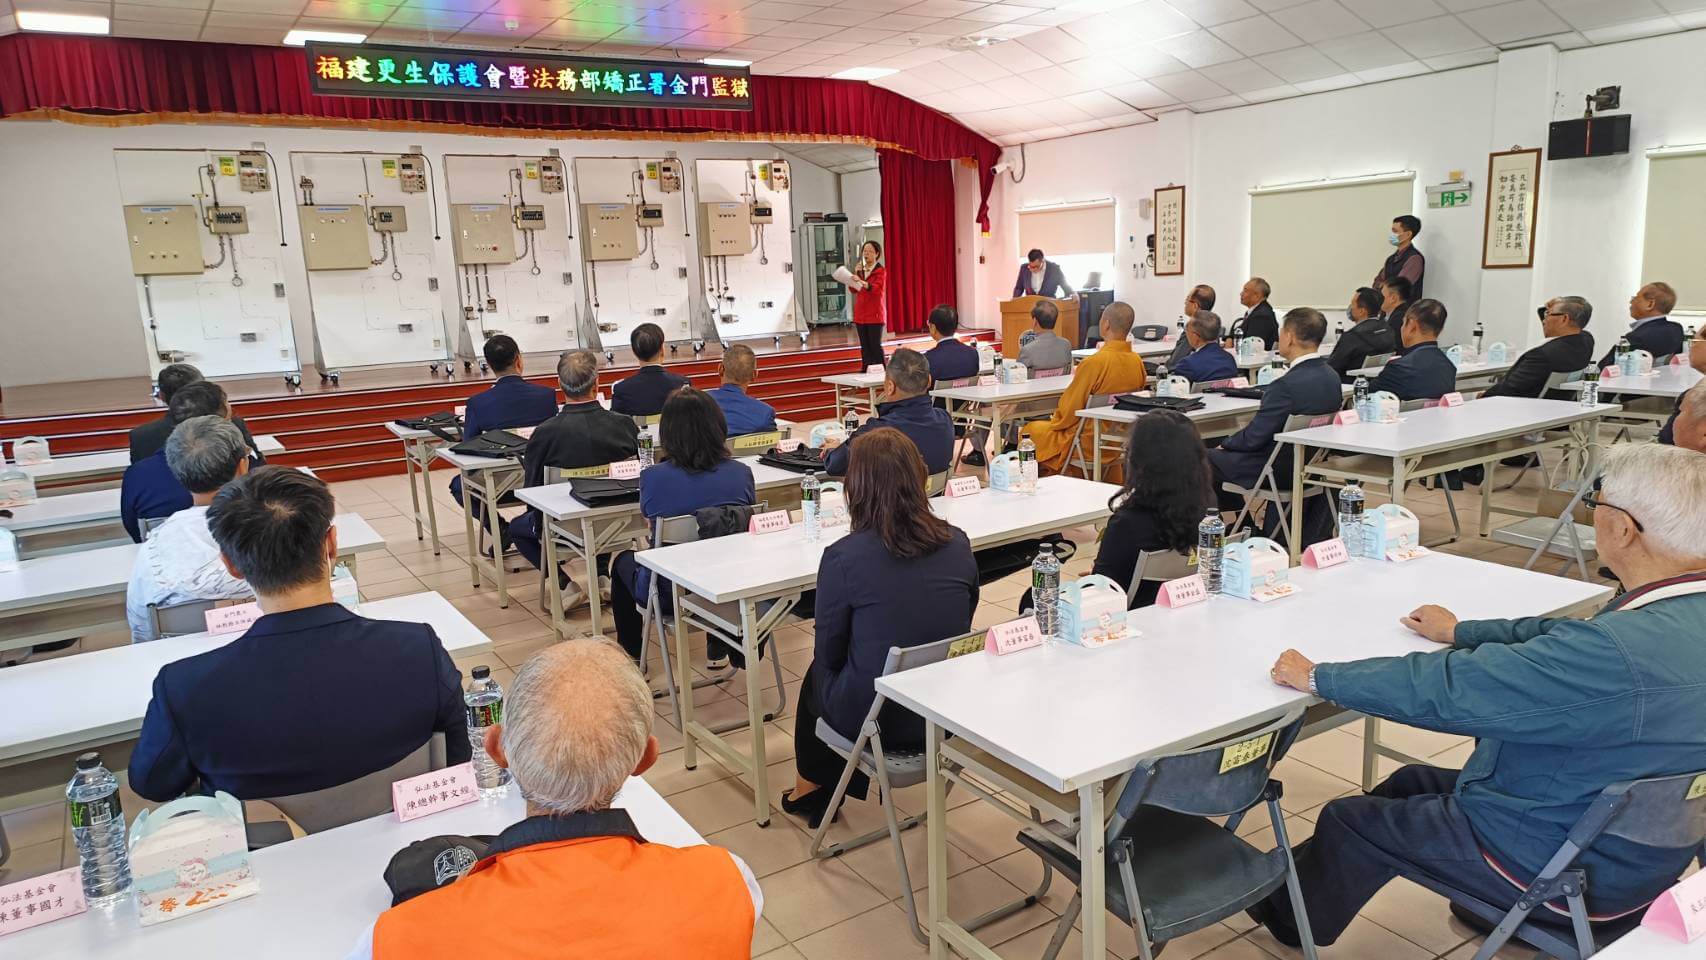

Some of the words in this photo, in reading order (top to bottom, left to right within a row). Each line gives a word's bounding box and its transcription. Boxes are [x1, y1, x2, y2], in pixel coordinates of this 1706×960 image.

[316, 55, 750, 98] 福建更生保護會暨法務部矯正署金門監獄
[414, 776, 456, 793] 弘法基金會
